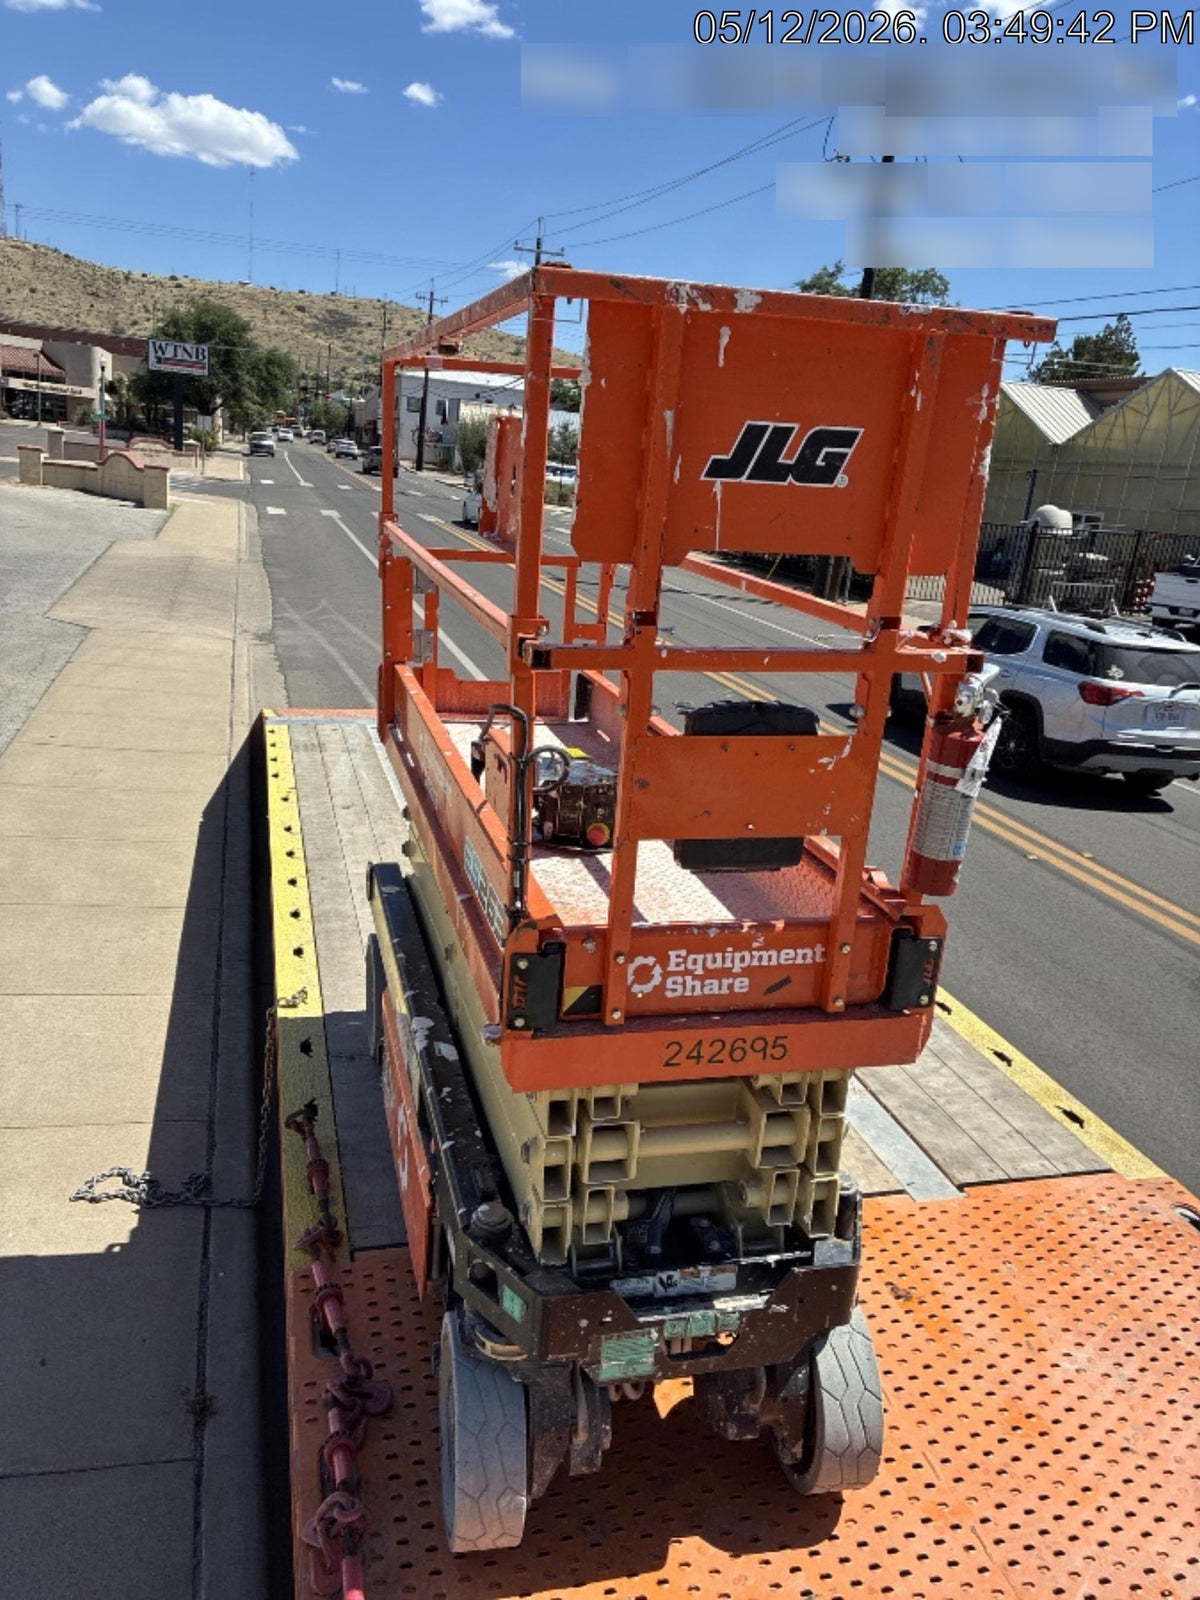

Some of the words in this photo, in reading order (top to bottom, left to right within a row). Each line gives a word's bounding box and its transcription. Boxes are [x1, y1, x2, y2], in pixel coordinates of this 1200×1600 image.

[151, 341, 207, 360] WTNB
[699, 420, 864, 488] JLG
[666, 943, 826, 974] Equipment
[665, 975, 750, 998] Share
[663, 1036, 788, 1067] 242695
